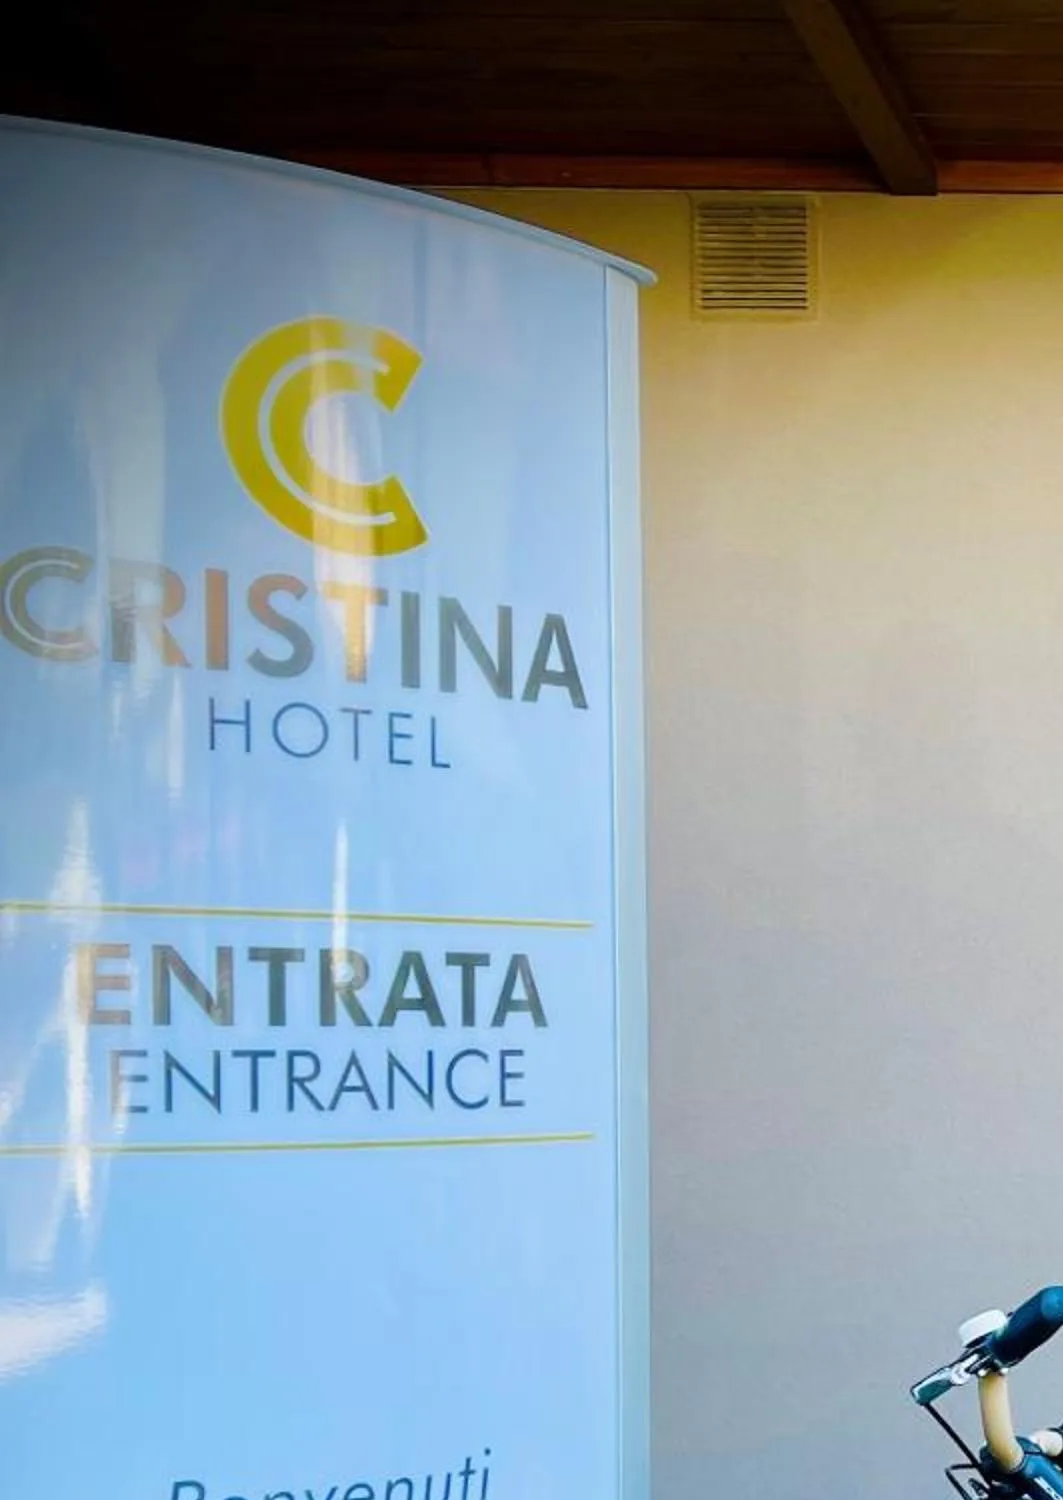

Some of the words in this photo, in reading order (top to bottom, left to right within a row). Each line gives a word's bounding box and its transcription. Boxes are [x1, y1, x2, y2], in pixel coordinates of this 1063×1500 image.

[1, 545, 590, 710] CRISTINA
[208, 697, 452, 769] HOTEL
[76, 942, 549, 1029] ENTRATA
[110, 1047, 527, 1115] ENTRANCE
